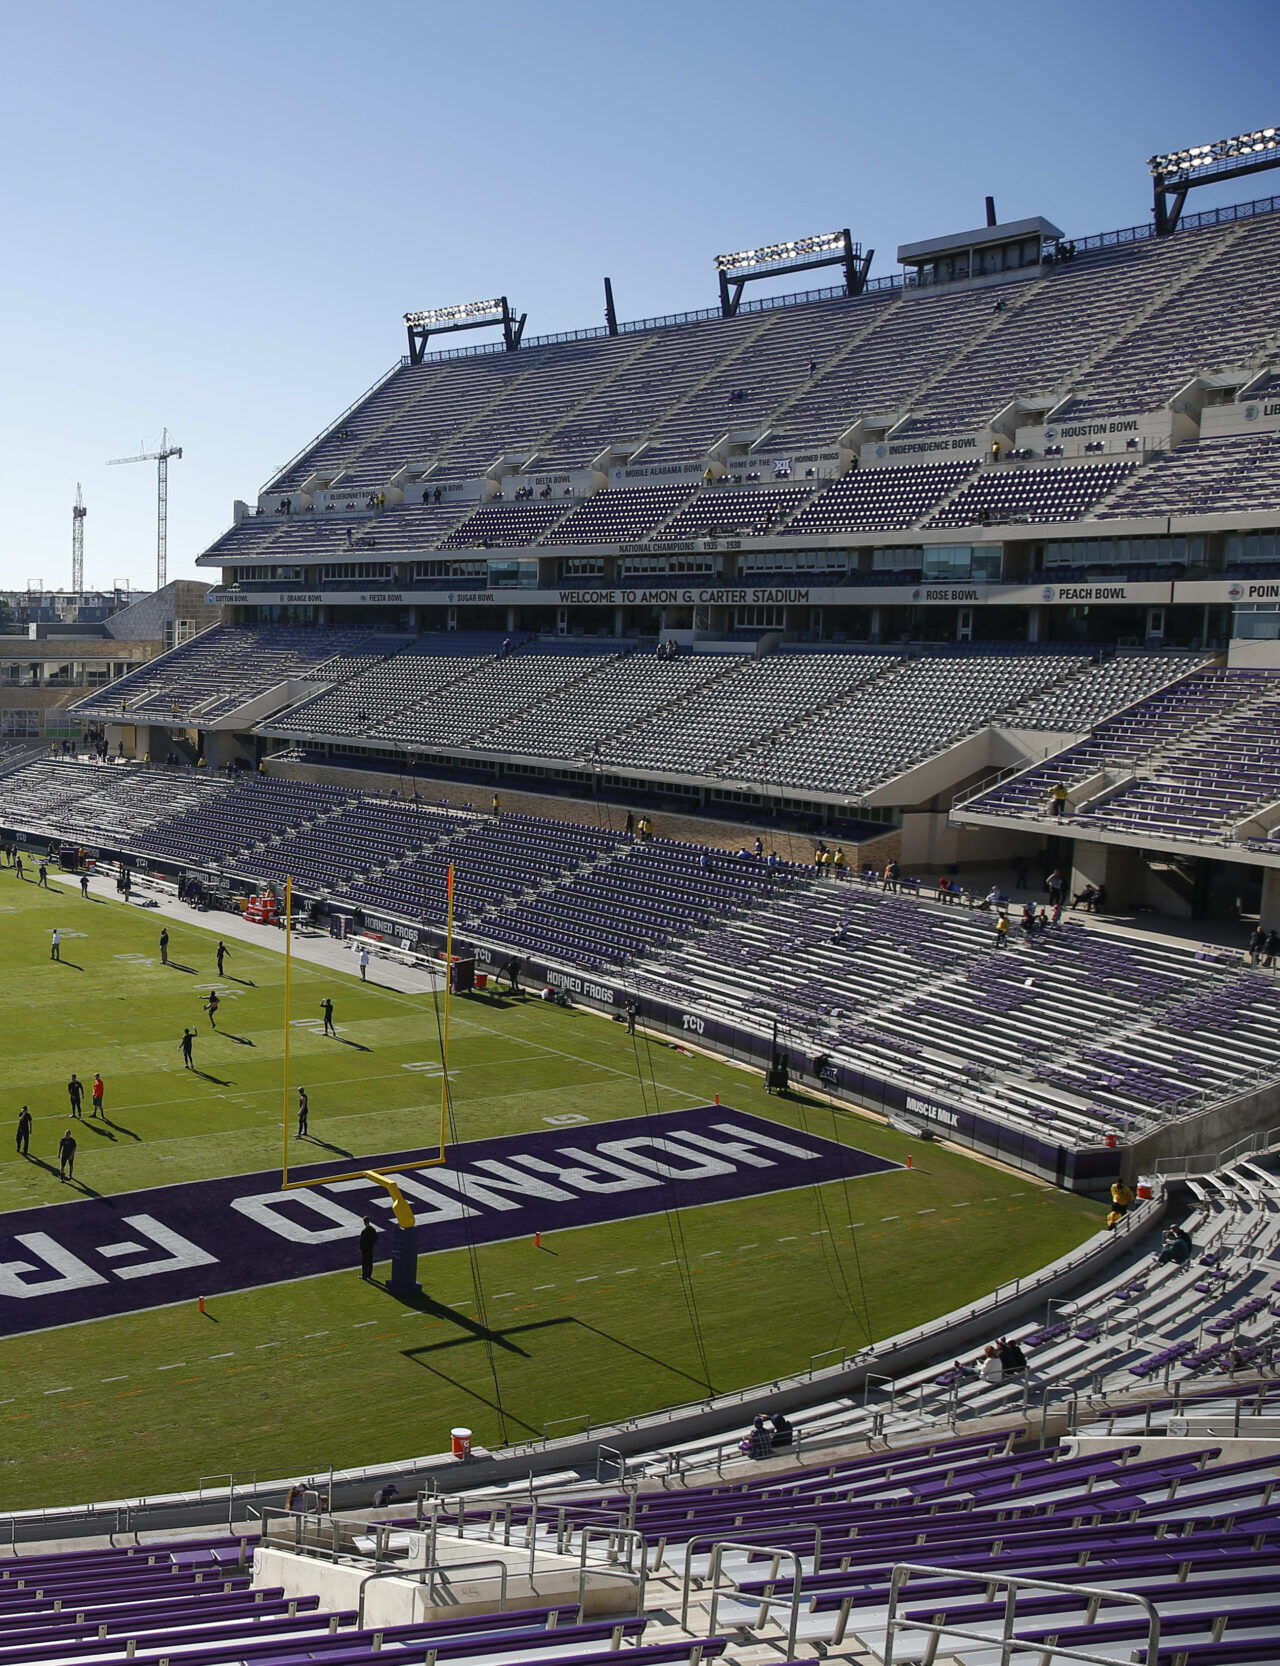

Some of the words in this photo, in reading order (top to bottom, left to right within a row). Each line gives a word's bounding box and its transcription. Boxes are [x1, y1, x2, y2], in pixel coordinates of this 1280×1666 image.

[1061, 424, 1106, 438] HOUSTON
[1109, 420, 1139, 432] BOWL
[889, 440, 950, 455] INDEPENDENCE
[952, 437, 977, 449] BOWL
[794, 454, 818, 463] HORNED
[820, 452, 839, 460] FROGS
[625, 469, 648, 478] MOBILE
[650, 466, 681, 476] ALABAMA
[683, 464, 703, 473] BOWL
[535, 477, 552, 485] DELTA
[553, 475, 571, 484] BOWL
[448, 484, 464, 492] BOWL
[330, 492, 361, 500] BLUEBONNET
[620, 544, 652, 553] NATIONAL
[653, 542, 695, 552] CHAMPIONS
[703, 541, 718, 550] 1935
[726, 540, 741, 549] 1938
[457, 594, 476, 602] SUGAR
[559, 591, 616, 604] WELCOME
[621, 591, 636, 603] TO
[640, 590, 677, 603] AMON
[682, 590, 695, 603] G.
[699, 590, 746, 603] CARTER
[753, 589, 809, 603] STADIUM
[926, 590, 949, 600] ROSE
[951, 590, 979, 600] BOWL
[1059, 588, 1092, 599] PEACH
[1095, 588, 1126, 599] BOWL
[365, 916, 393, 934] HORNED
[394, 924, 419, 942] FROGS
[474, 948, 491, 964] TCU
[547, 970, 581, 993] HORNED
[583, 983, 614, 1003] FROGS
[682, 1014, 705, 1034] TCU
[906, 1097, 937, 1119] MUSCLE
[937, 1108, 959, 1126] MILK
[229, 1123, 823, 1245] HORNED
